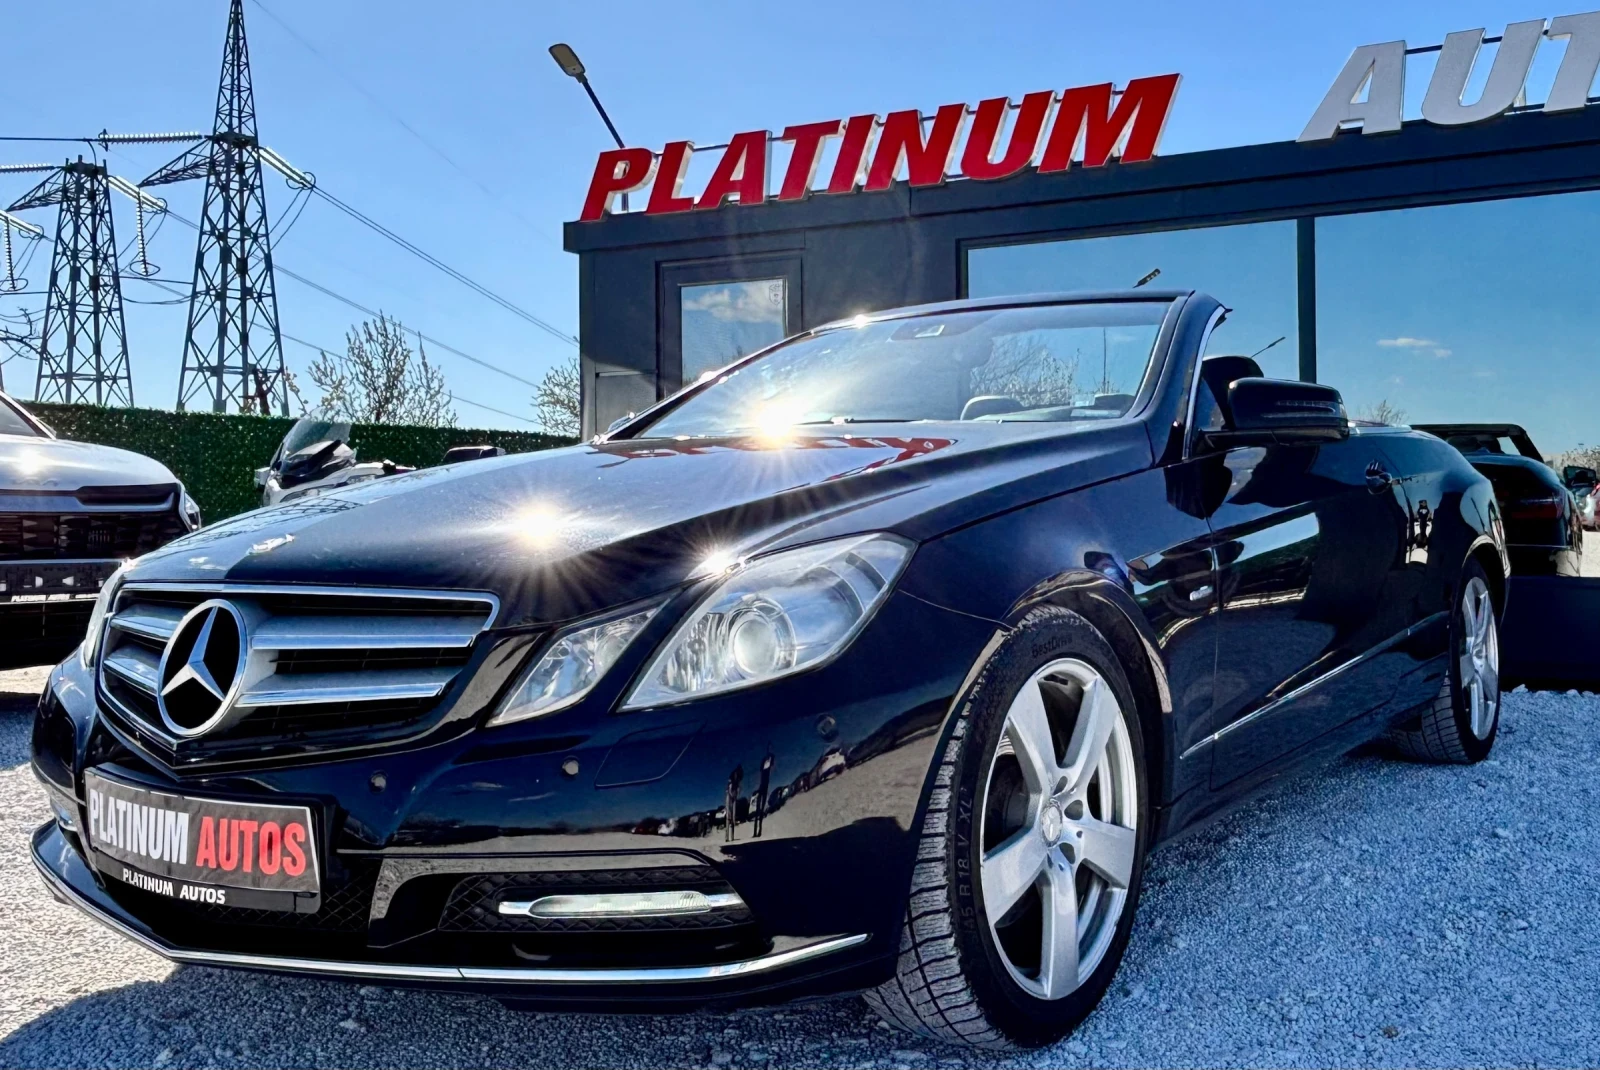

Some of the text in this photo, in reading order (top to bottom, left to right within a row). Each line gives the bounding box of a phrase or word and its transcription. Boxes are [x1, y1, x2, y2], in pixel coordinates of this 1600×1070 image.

[579, 73, 1183, 222] PLATINUM
[89, 788, 307, 877] PLATINUM AUTOS
[122, 867, 226, 905] PLATINUM AUTOS
